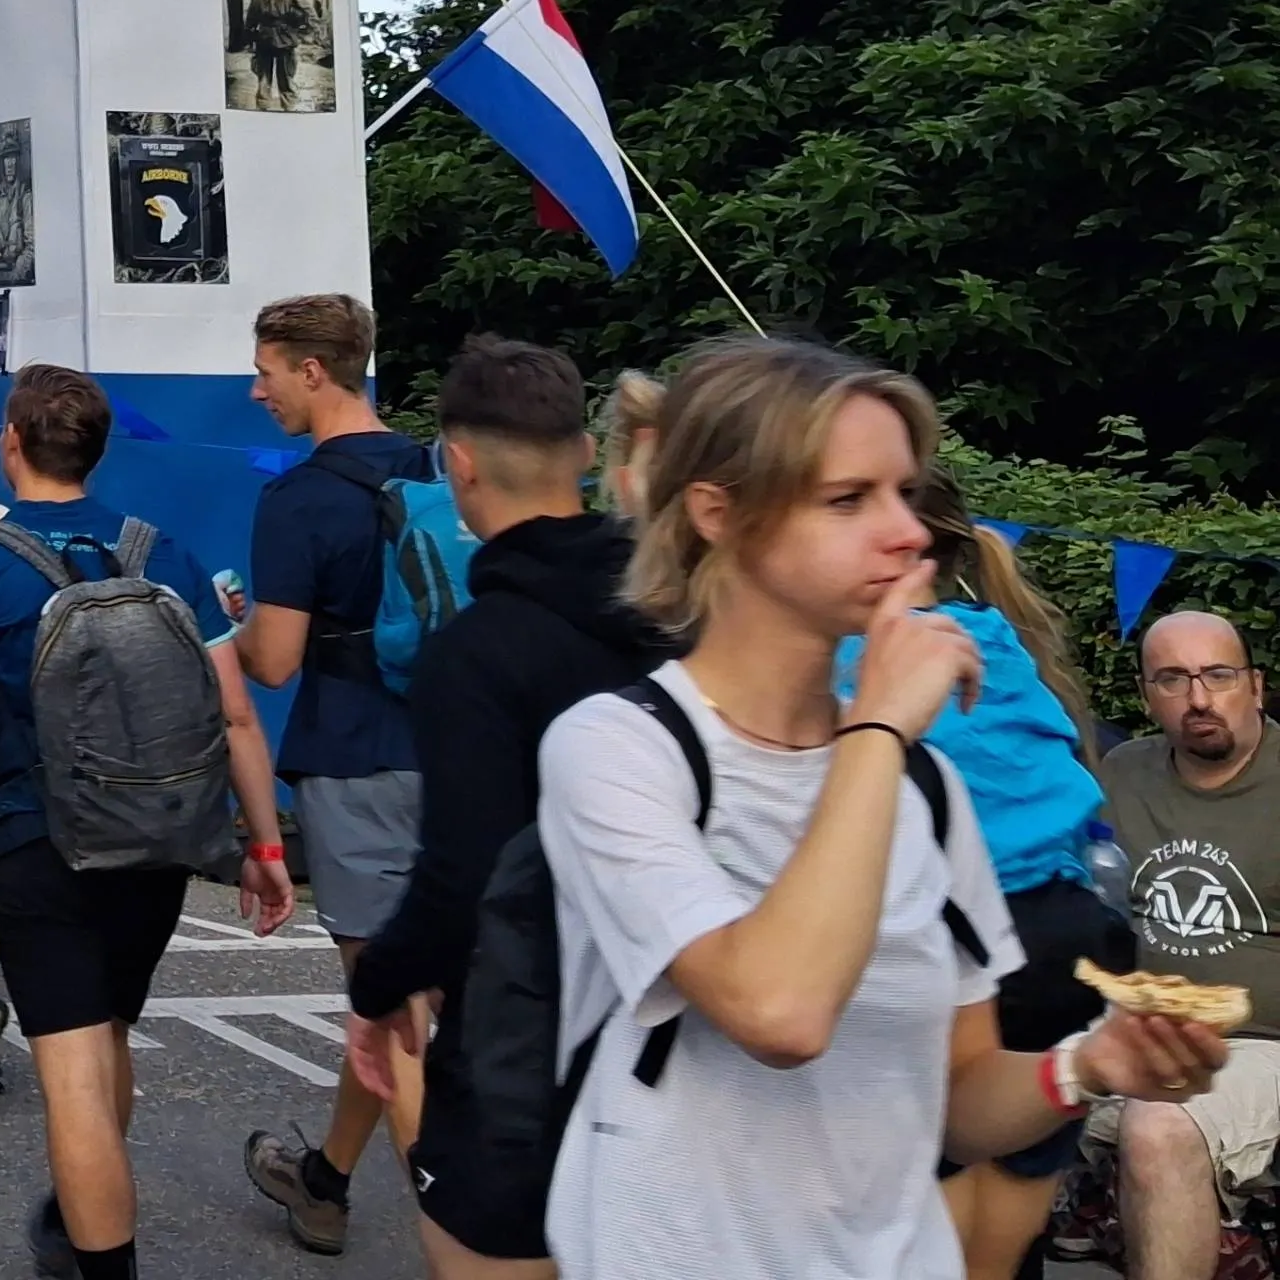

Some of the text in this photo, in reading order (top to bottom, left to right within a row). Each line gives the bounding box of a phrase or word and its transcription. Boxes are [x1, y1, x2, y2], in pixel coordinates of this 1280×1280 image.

[1151, 838, 1229, 866] TEAM 243
[1162, 943, 1200, 957] VOOR
